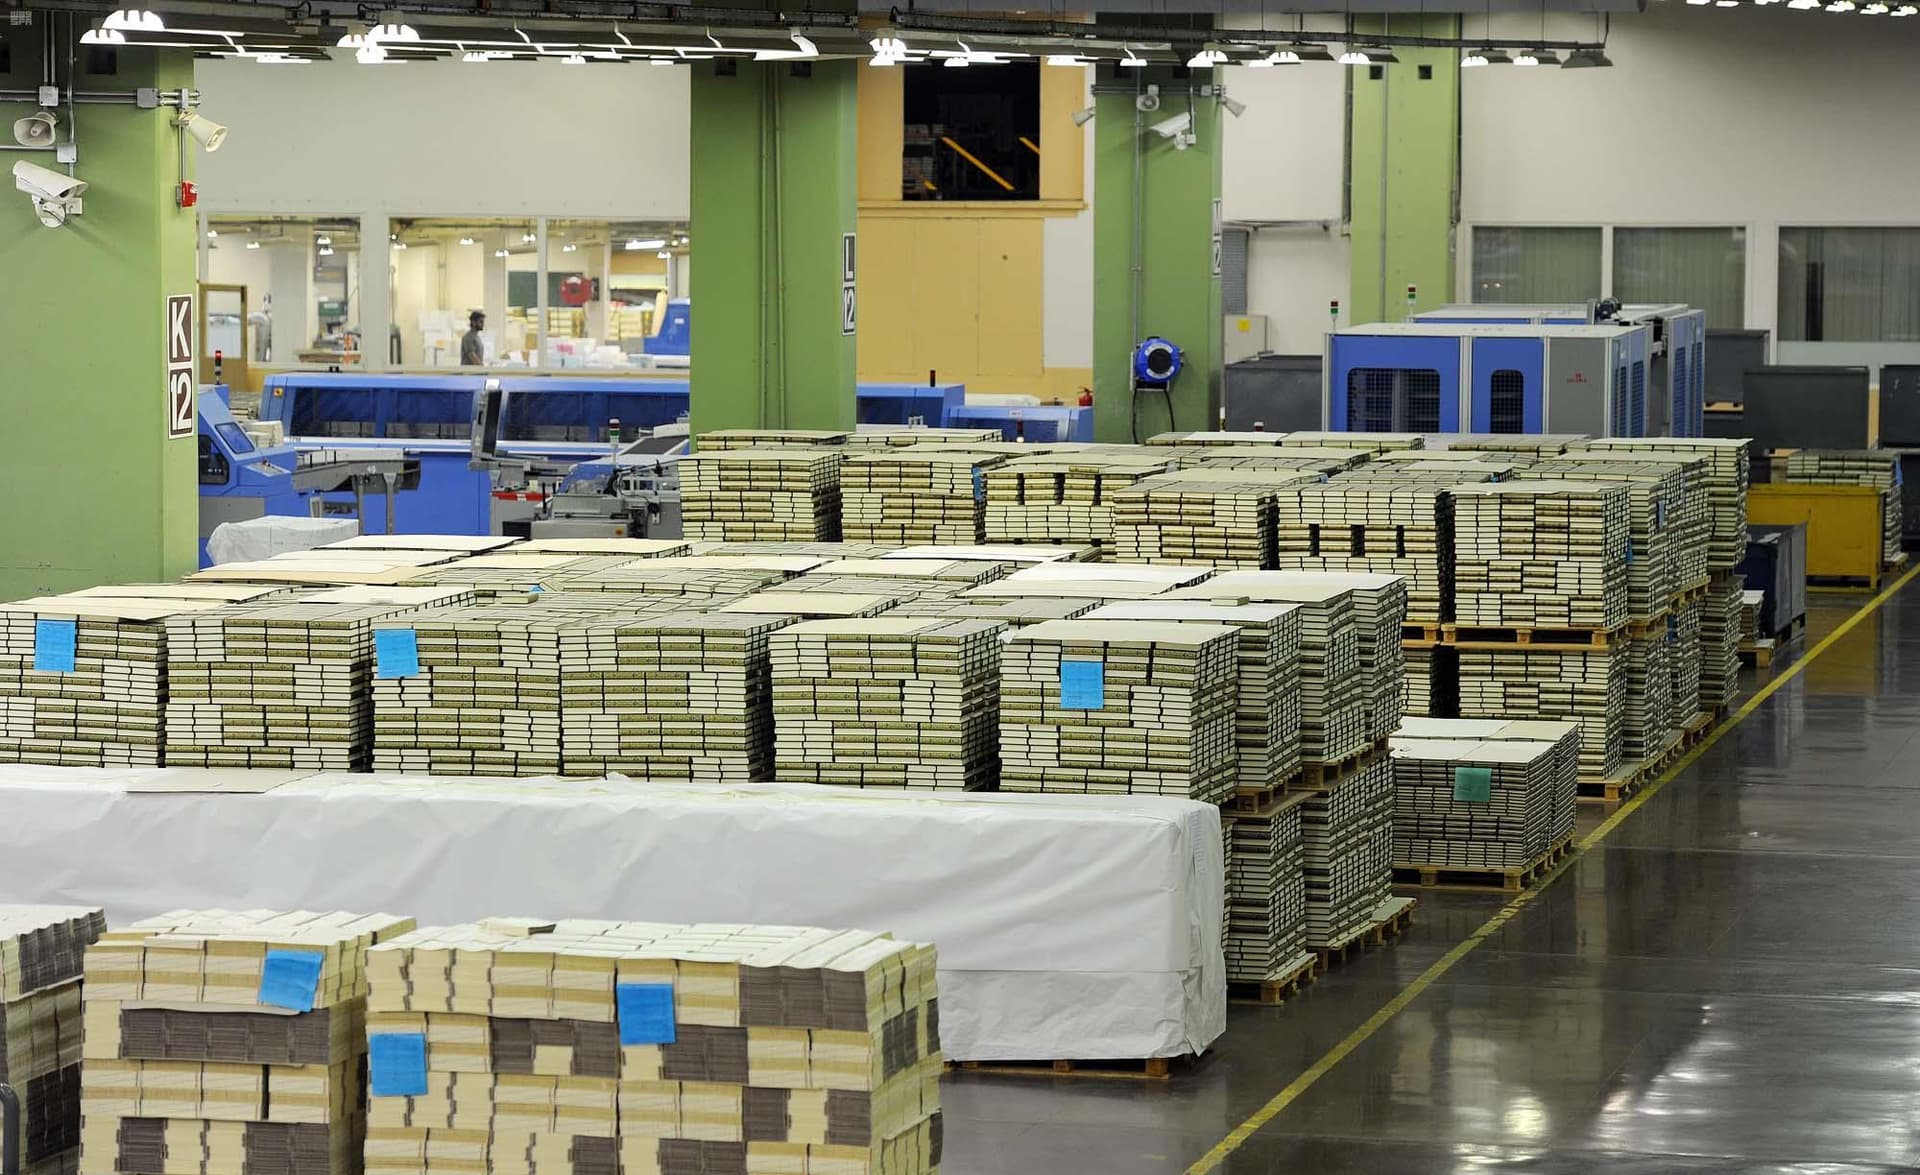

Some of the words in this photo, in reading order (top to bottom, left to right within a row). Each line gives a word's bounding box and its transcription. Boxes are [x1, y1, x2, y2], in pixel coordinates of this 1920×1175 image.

[845, 239, 854, 279] L
[171, 301, 190, 358] K
[844, 289, 854, 329] 12
[171, 372, 192, 430] 12
